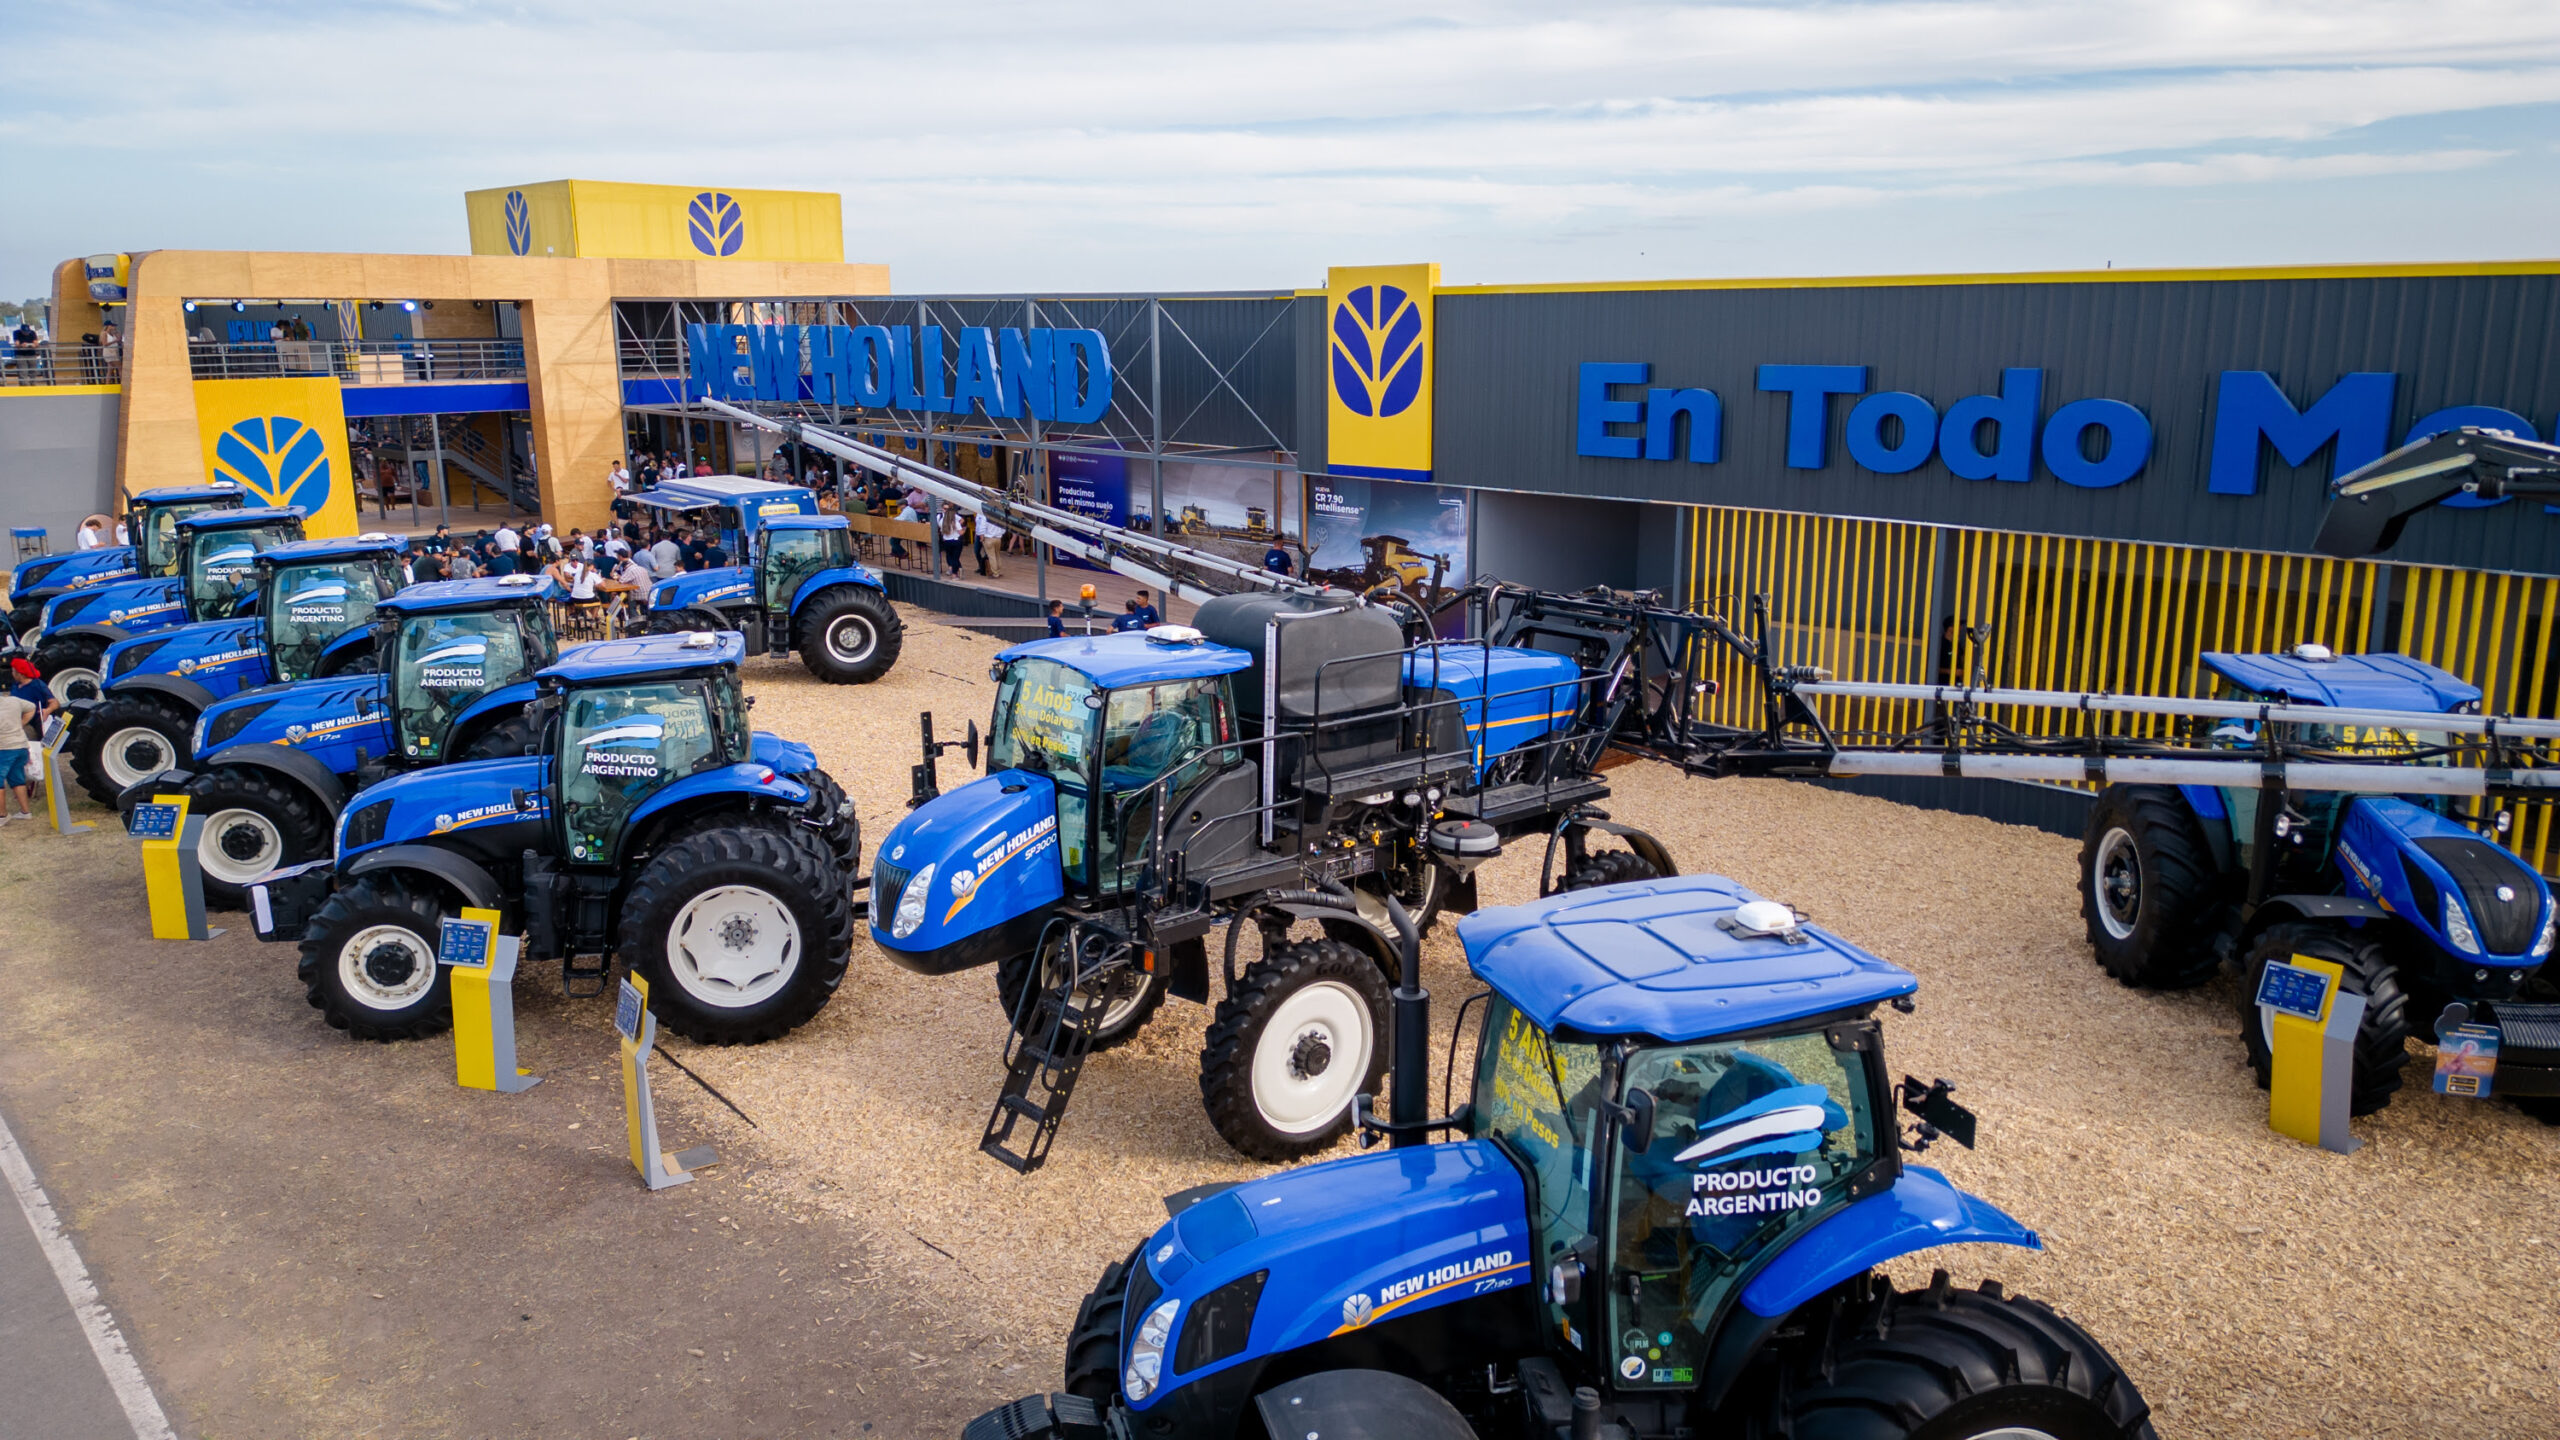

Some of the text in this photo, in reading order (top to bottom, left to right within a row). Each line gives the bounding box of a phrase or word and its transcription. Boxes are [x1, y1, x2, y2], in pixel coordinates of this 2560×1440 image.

[687, 323, 1112, 424] NEW HOLLAND
[1577, 362, 1722, 465] En
[1757, 364, 2153, 489] Todo
[1059, 486, 1095, 498] Producimos
[1315, 493, 1344, 504] CR 7.90
[1068, 497, 1074, 505] el
[1074, 498, 1096, 508] mismo
[1096, 501, 1113, 510] suelo
[88, 567, 137, 580] NEW HOLLAND
[207, 567, 252, 575] PRODUCTO
[707, 582, 750, 598] NEW HOLLAND
[128, 600, 182, 616] NEW HOLLAND
[291, 606, 343, 615] PRODUCTO
[290, 615, 345, 623] ARGENTINO
[200, 653, 221, 665] NEW
[423, 668, 482, 677] PRODUCTO
[420, 678, 485, 687] ARGENTINO
[1021, 680, 1073, 712] 5 Años
[311, 721, 336, 732] NEW
[1040, 709, 1074, 729] Dólares
[2343, 725, 2356, 743] 5
[1030, 735, 1041, 746] en
[1042, 736, 1068, 753] Pesos
[585, 752, 656, 765] PRODUCTO
[581, 764, 658, 777] ARGENTINO
[457, 805, 484, 821] NEW
[977, 844, 1006, 875] NEW
[1006, 814, 1056, 854] HOLLAND
[1025, 832, 1058, 861] SP3000
[1508, 1007, 1522, 1041] 5
[1512, 1099, 1559, 1149] en Pesos
[1693, 1164, 1817, 1193] PRODUCTO
[1685, 1187, 1822, 1217] ARGENTINO
[1381, 1250, 1513, 1304] NEW HOLLAND
[1473, 1277, 1513, 1294] T7.190
